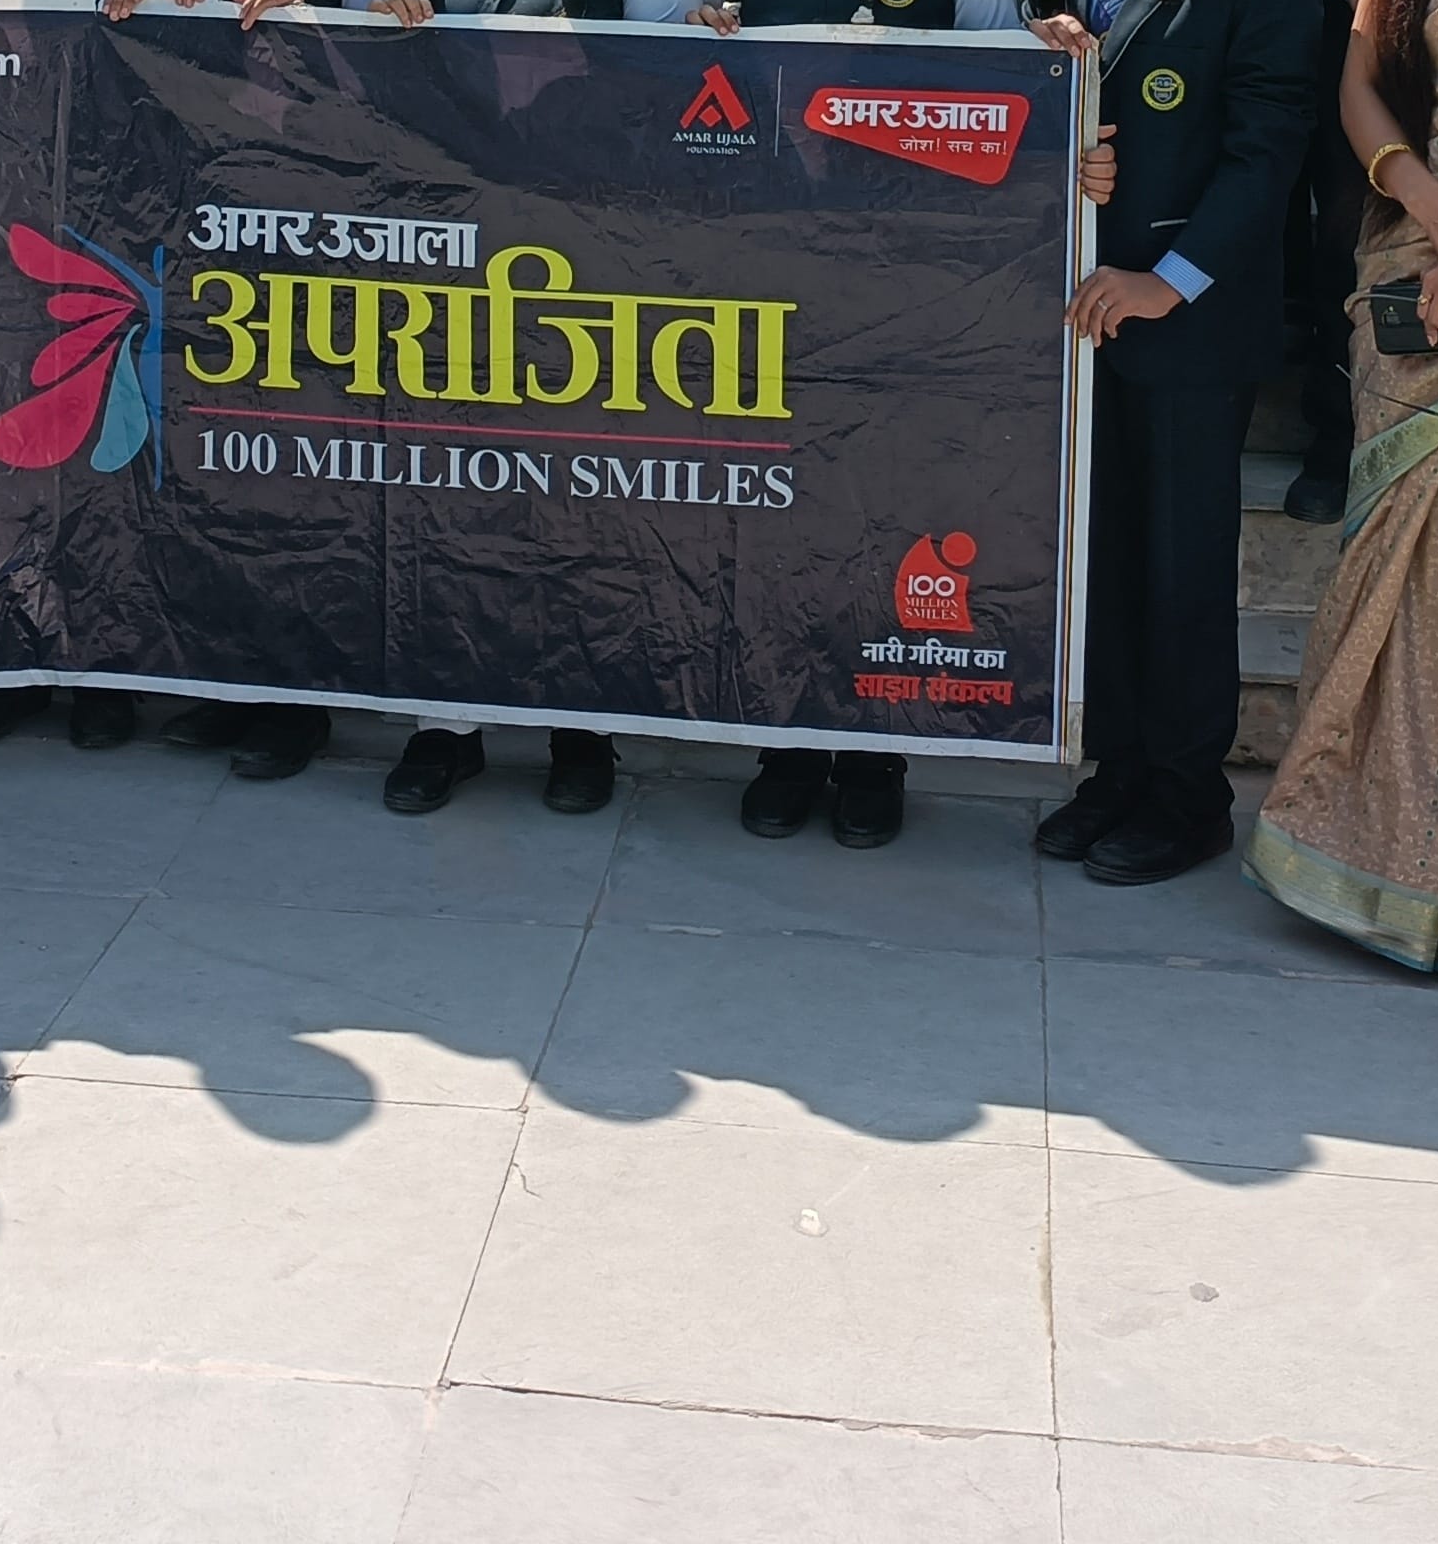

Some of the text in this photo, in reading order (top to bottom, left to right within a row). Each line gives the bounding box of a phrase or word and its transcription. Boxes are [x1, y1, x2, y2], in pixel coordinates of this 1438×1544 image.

[820, 97, 1009, 132] अमर उजाला
[672, 132, 756, 146] AMAR UJALA
[686, 146, 740, 155] FOUNDATION
[946, 140, 975, 154] सच
[188, 203, 479, 268] अमर उजाला
[184, 245, 798, 419] अपराजिता
[196, 428, 795, 509] 100 MILLION SMILES
[907, 574, 956, 597] 100
[904, 597, 959, 609] MILLION
[905, 609, 959, 620] SMILES
[861, 636, 1007, 670] नारी गरिमा का
[926, 671, 1014, 705] संकल्प
